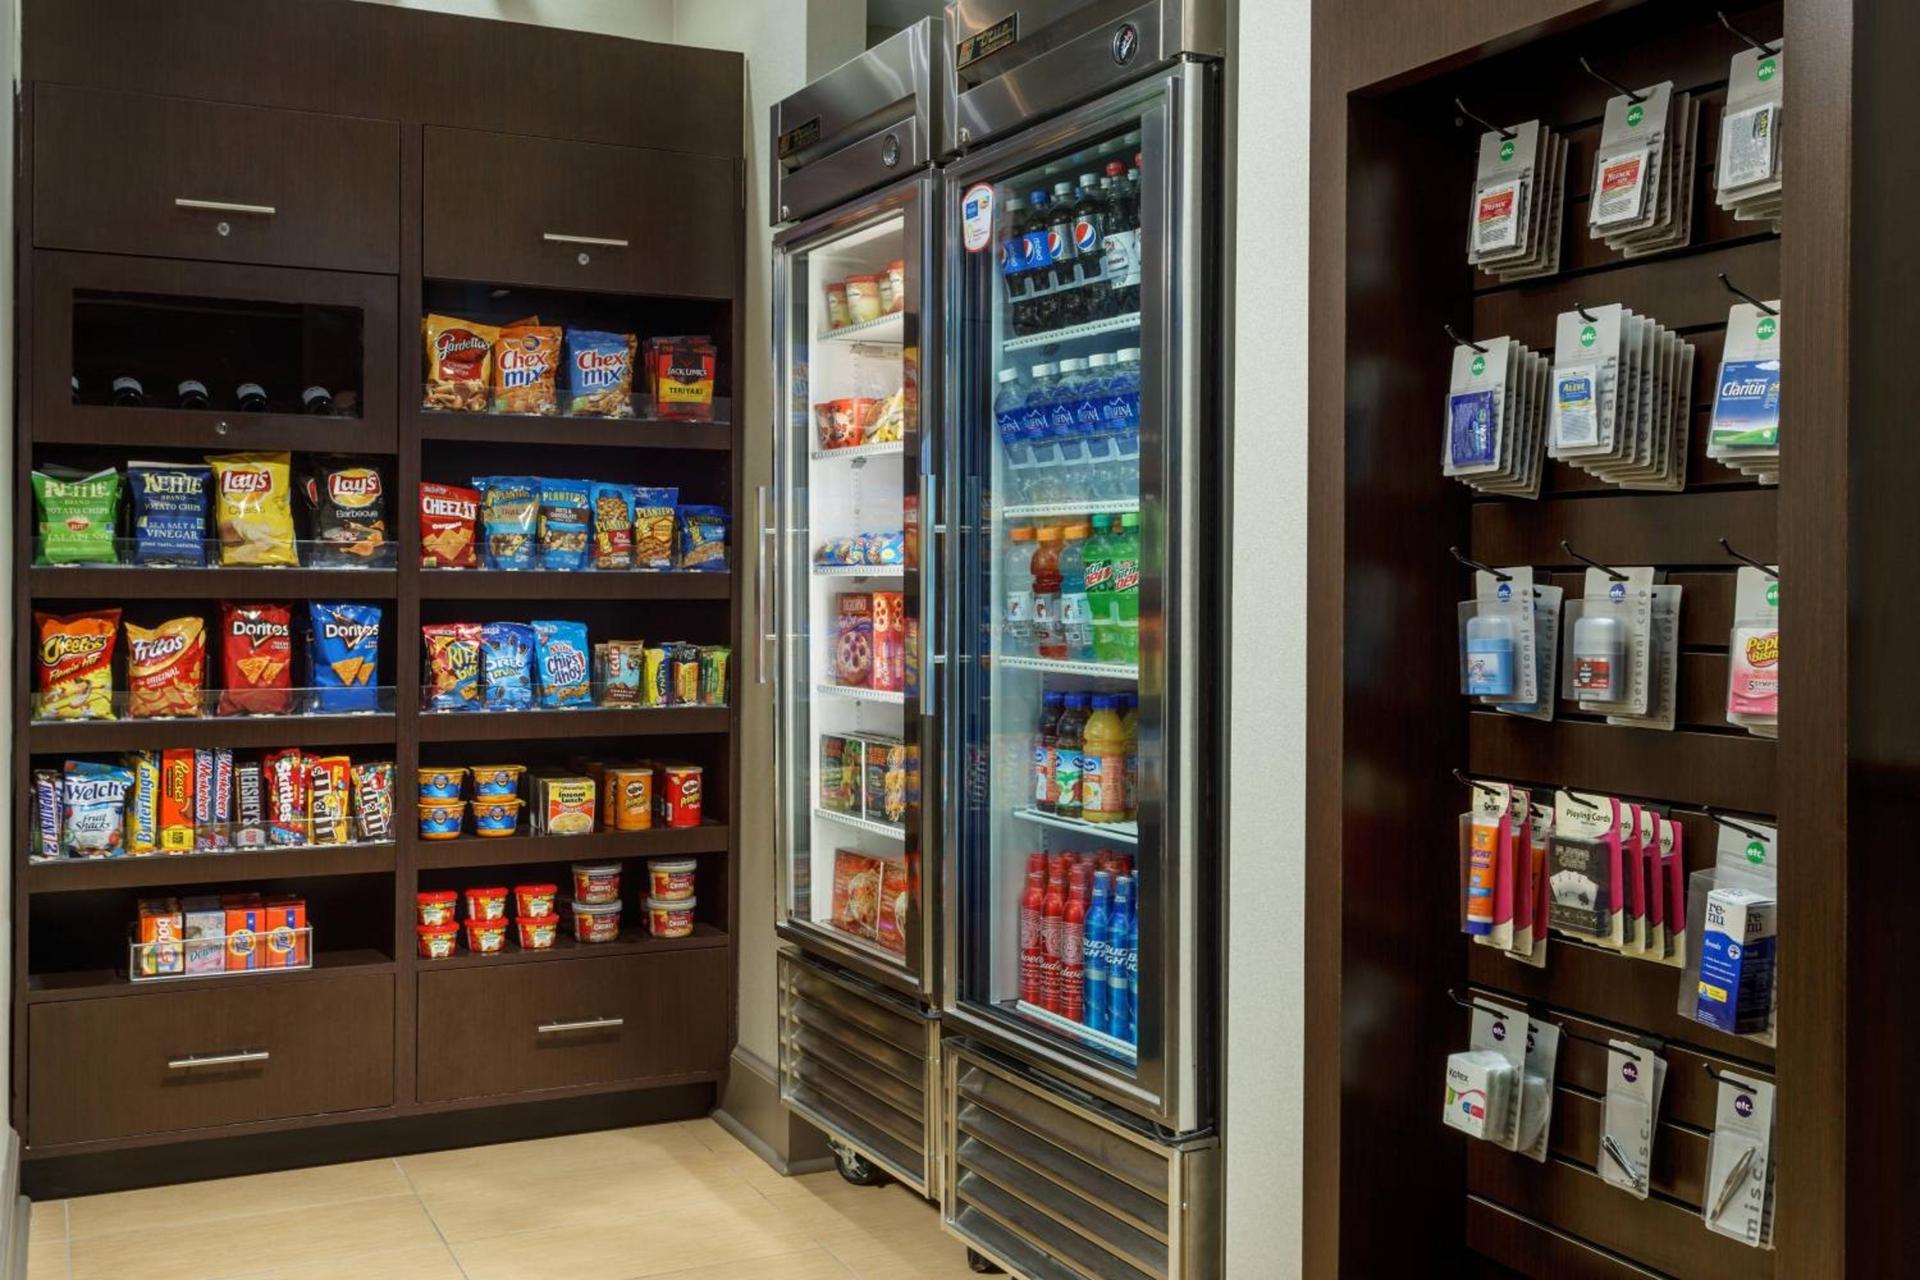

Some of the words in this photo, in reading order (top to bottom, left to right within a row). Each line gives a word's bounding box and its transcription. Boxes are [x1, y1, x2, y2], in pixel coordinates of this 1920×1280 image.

[499, 350, 547, 369] Chex
[578, 351, 625, 368] Chex
[668, 387, 704, 395] TERIYAKI
[1722, 381, 1766, 396] Claritin
[1600, 356, 1616, 447] health
[223, 471, 267, 492] Lay's
[334, 476, 377, 495] Lay's
[146, 529, 198, 539] VINEGAR
[1522, 590, 1530, 621] care
[1638, 590, 1648, 625] care
[233, 622, 289, 635] Doritos
[326, 624, 379, 637] Doritos
[43, 635, 106, 662] Cheetos
[133, 636, 183, 663] Fritos
[547, 653, 578, 671] Chips
[1522, 629, 1534, 697] personal
[1634, 632, 1645, 708] personal
[67, 782, 128, 801] Welch's
[241, 768, 260, 827] HERSHEY'S
[275, 762, 292, 822] Skittles
[136, 768, 153, 844] Butterfinger
[82, 813, 106, 823] Fruit
[1747, 848, 1766, 858] etc.
[1708, 912, 1725, 926] nu
[1623, 1068, 1638, 1077] etc.
[1736, 1101, 1753, 1112] etc.
[1745, 1157, 1766, 1242] misc.
